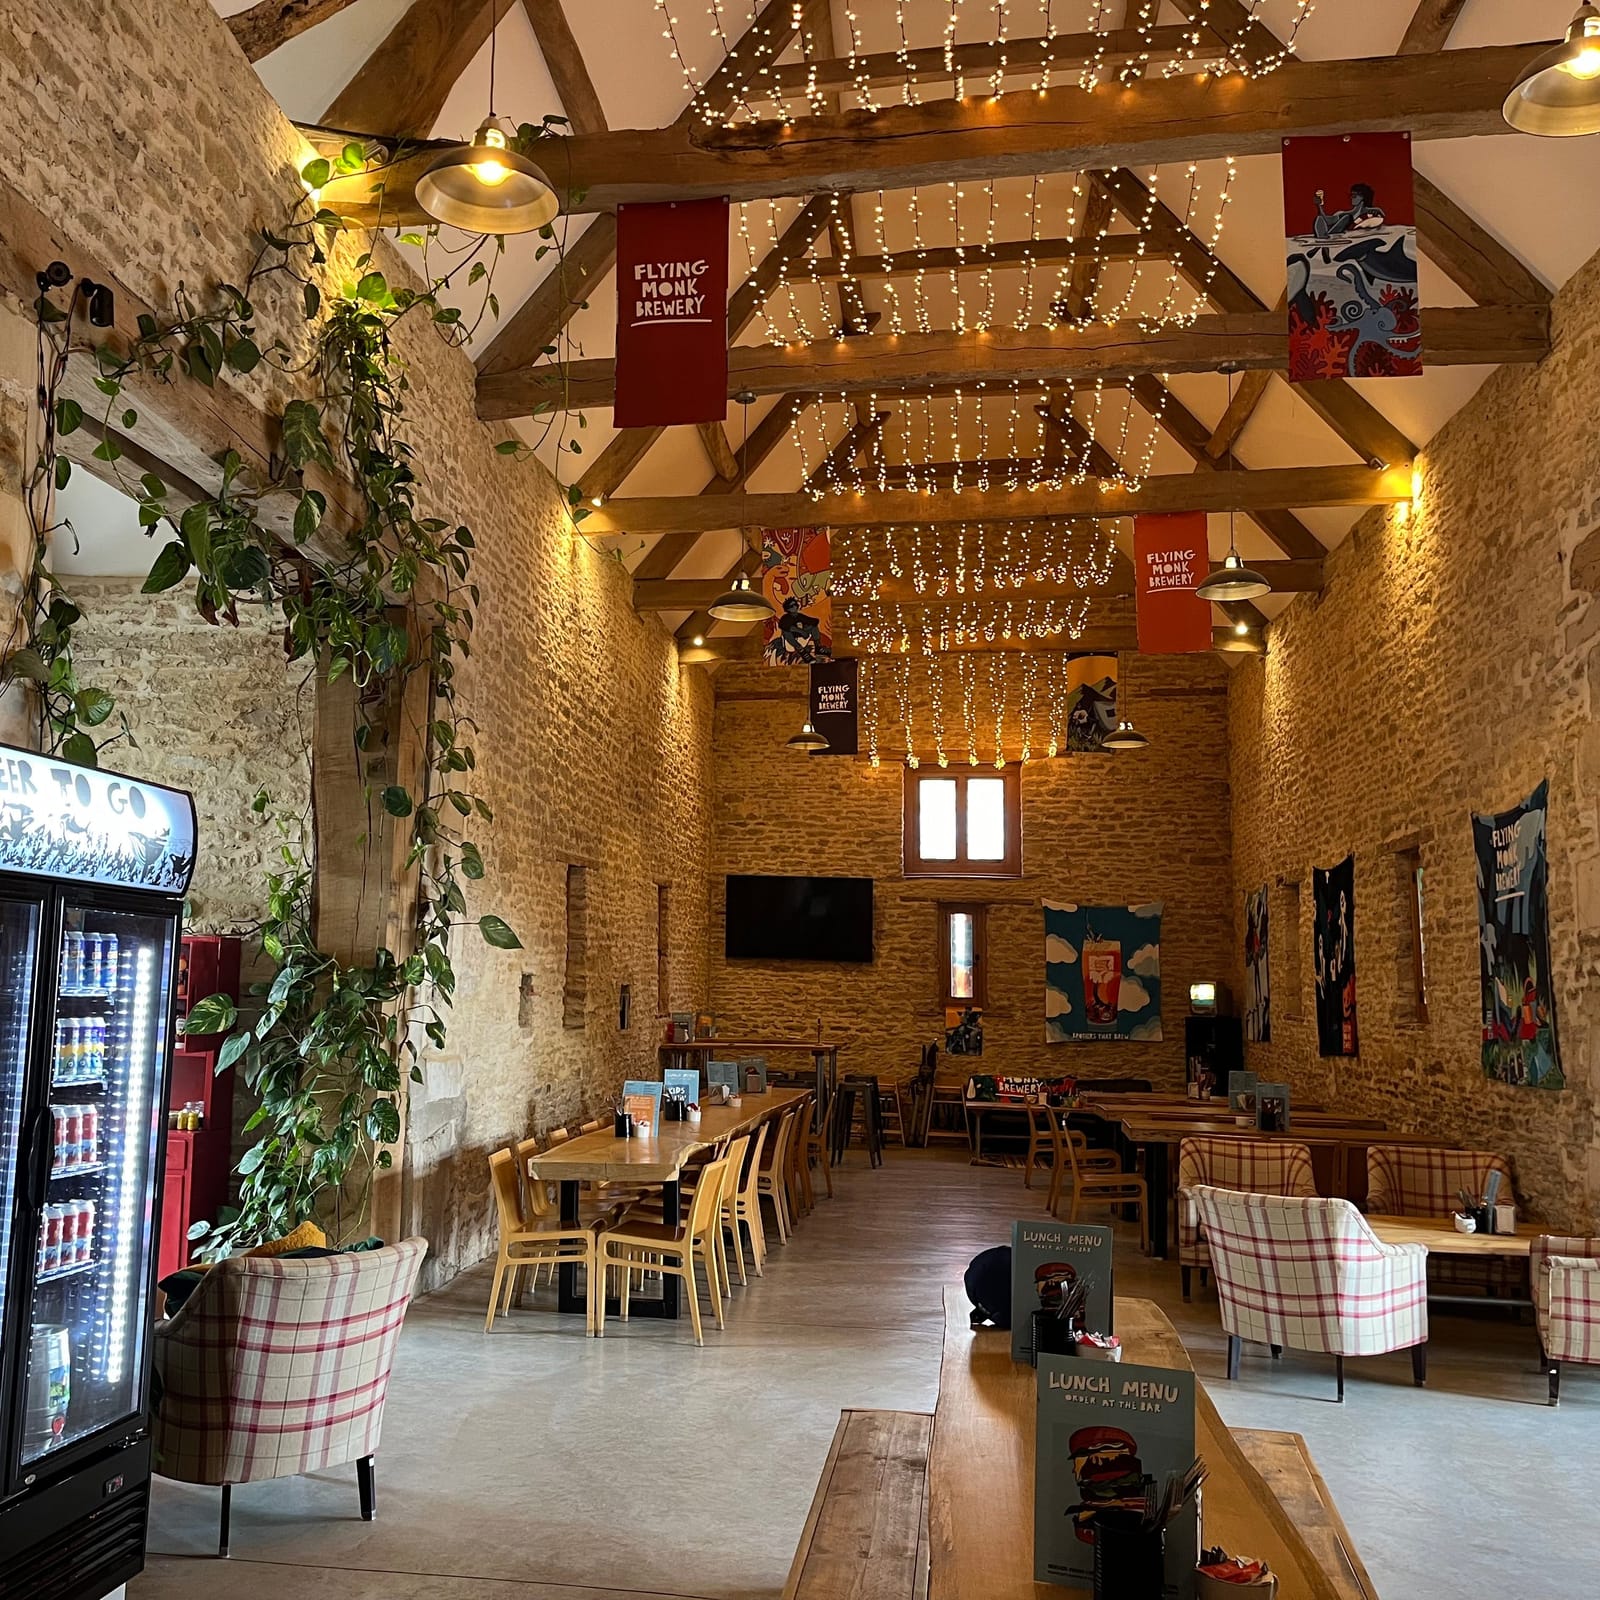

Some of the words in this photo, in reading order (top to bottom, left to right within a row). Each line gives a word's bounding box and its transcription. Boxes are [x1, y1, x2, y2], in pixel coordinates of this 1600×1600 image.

[634, 260, 709, 280] FLYING
[642, 278, 698, 298] MONK
[635, 294, 706, 317] BREWERY
[1146, 549, 1196, 564] FLYING
[1152, 561, 1189, 575] MONK
[1149, 572, 1195, 587] BREWERY
[817, 684, 850, 694] FLYING
[818, 700, 849, 710] BREWERY
[821, 693, 845, 702] MONK
[0, 757, 38, 795] EER
[51, 768, 92, 807] TO
[107, 782, 146, 819] GO
[1492, 820, 1521, 848] FLYING
[999, 1081, 1044, 1094] BREWERY
[1023, 1231, 1061, 1243] LUNCH
[1068, 1235, 1102, 1247] MENU
[1049, 1371, 1110, 1393] LUNCH
[1122, 1380, 1179, 1403] MENU
[1065, 1394, 1096, 1405] ORDER
[1102, 1398, 1115, 1407] AT
[1118, 1400, 1137, 1410] THE
[1140, 1402, 1161, 1413] BAR
